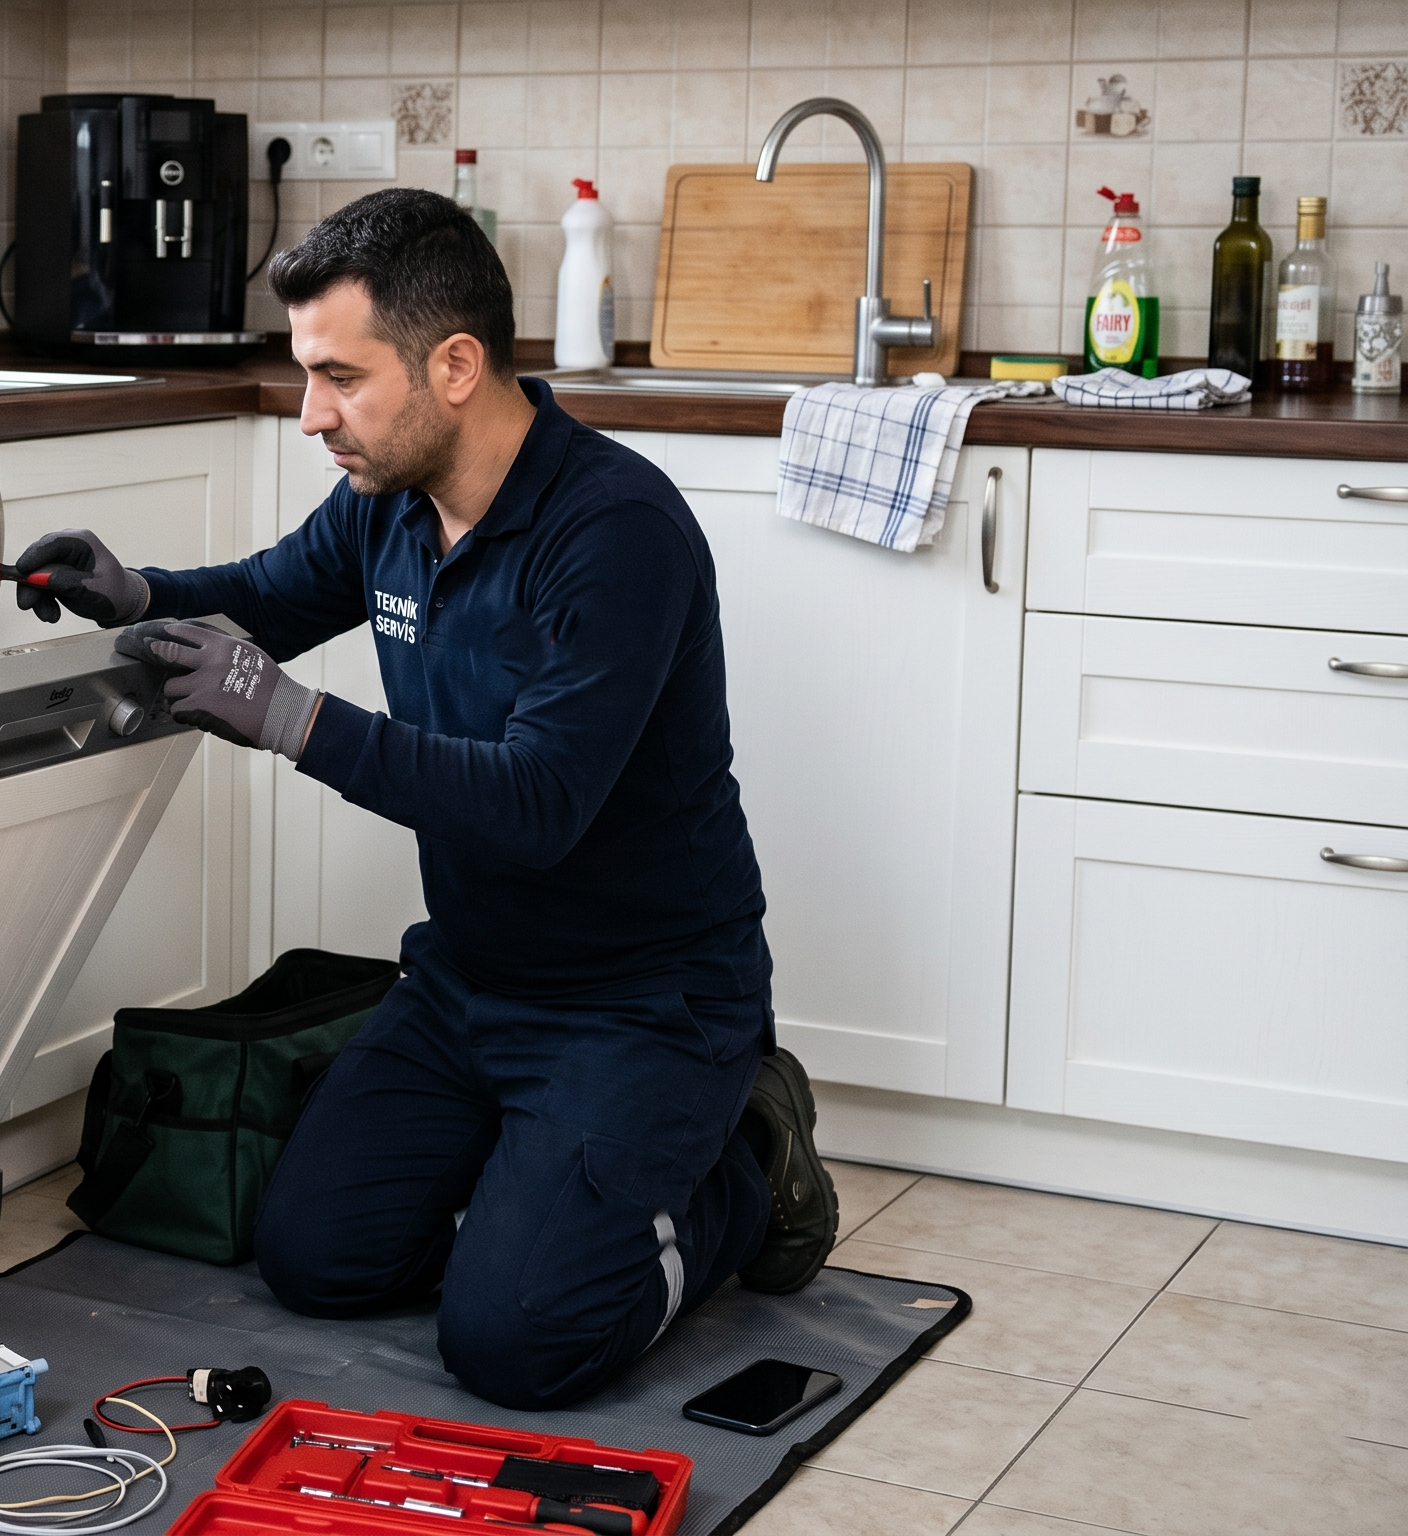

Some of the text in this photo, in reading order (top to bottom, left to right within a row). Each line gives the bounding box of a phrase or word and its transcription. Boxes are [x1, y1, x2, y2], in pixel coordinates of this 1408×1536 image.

[1096, 314, 1131, 332] FAIRY
[374, 590, 419, 620] TEKNİK
[376, 614, 416, 644] SERVİS
